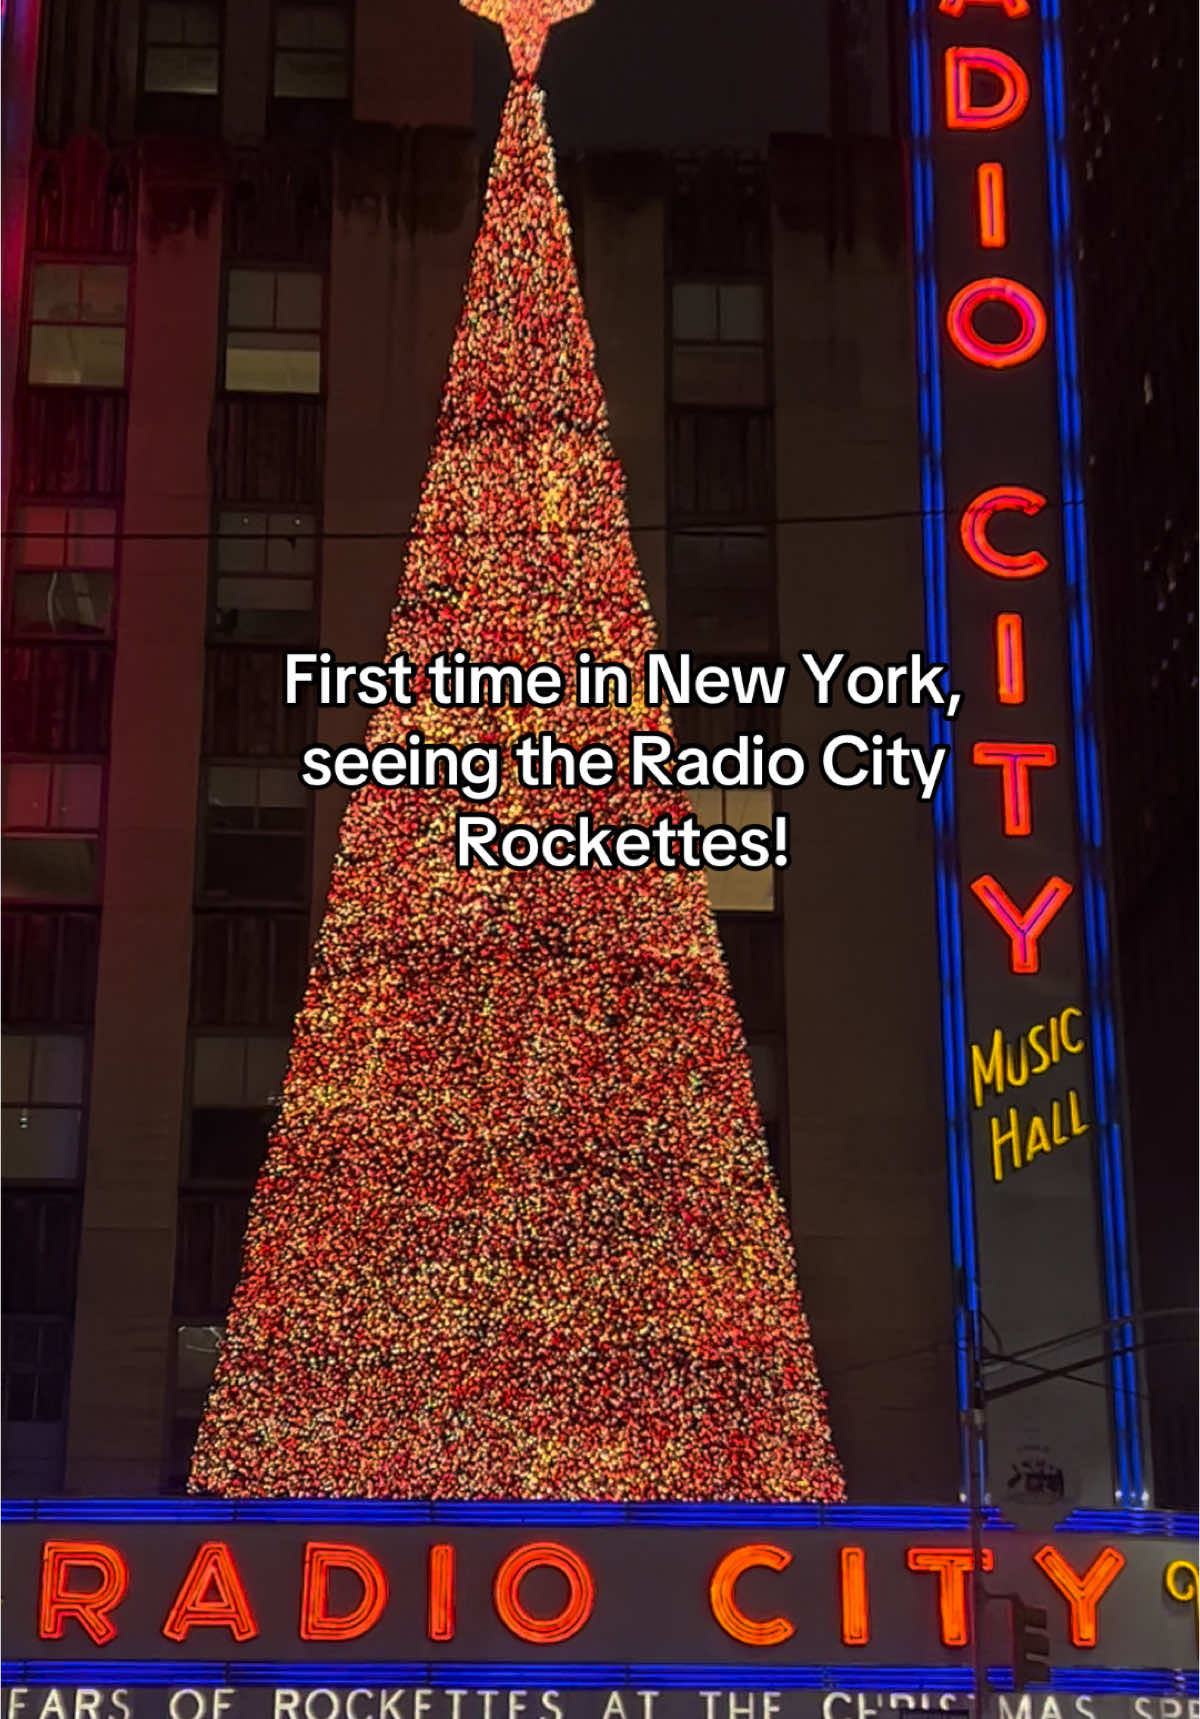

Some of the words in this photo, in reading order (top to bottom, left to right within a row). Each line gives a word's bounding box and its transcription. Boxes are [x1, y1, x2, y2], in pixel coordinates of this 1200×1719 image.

[939, 0, 1047, 369] DIO
[960, 486, 1073, 974] CITY
[971, 1007, 1085, 1108] MUSIC
[990, 1089, 1090, 1182] HALL
[39, 1541, 595, 1646] RADIO
[709, 1543, 1126, 1648] CITY
[168, 1687, 236, 1719] OF
[273, 1687, 564, 1719] ROCKETTES
[602, 1690, 661, 1719] AT
[699, 1690, 782, 1719] THE
